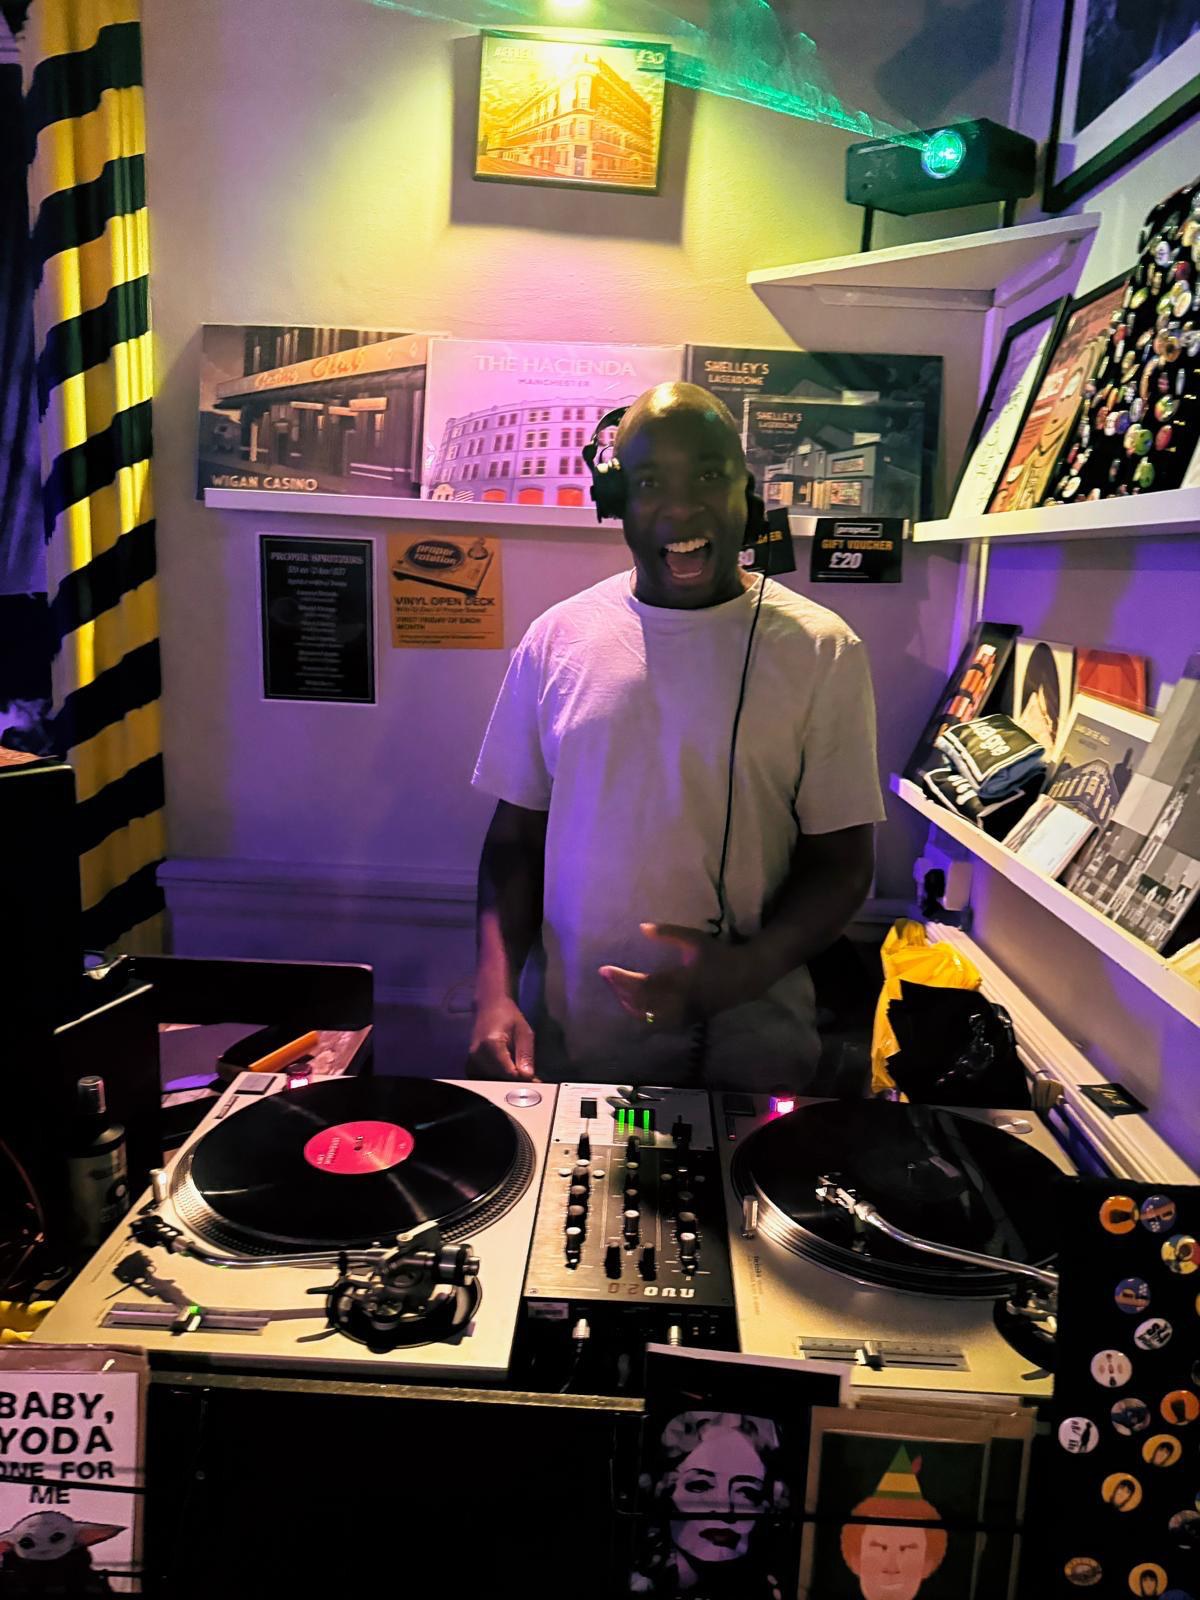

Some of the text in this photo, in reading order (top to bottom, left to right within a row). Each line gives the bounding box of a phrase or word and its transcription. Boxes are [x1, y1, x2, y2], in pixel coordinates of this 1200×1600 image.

[473, 354, 521, 372] THE
[704, 360, 769, 375] SHELLEY'S
[755, 411, 802, 422] SHELLEY'S
[210, 474, 318, 491] WIGAN CASINO
[822, 539, 894, 551] GIFT VOUCHER
[828, 552, 863, 569] £20
[396, 597, 496, 607] VINYL OPEN DECK
[0, 1391, 114, 1424] BABY,
[0, 1425, 113, 1455] YODA
[60, 1460, 115, 1480] FOR
[29, 1485, 71, 1504] ME
